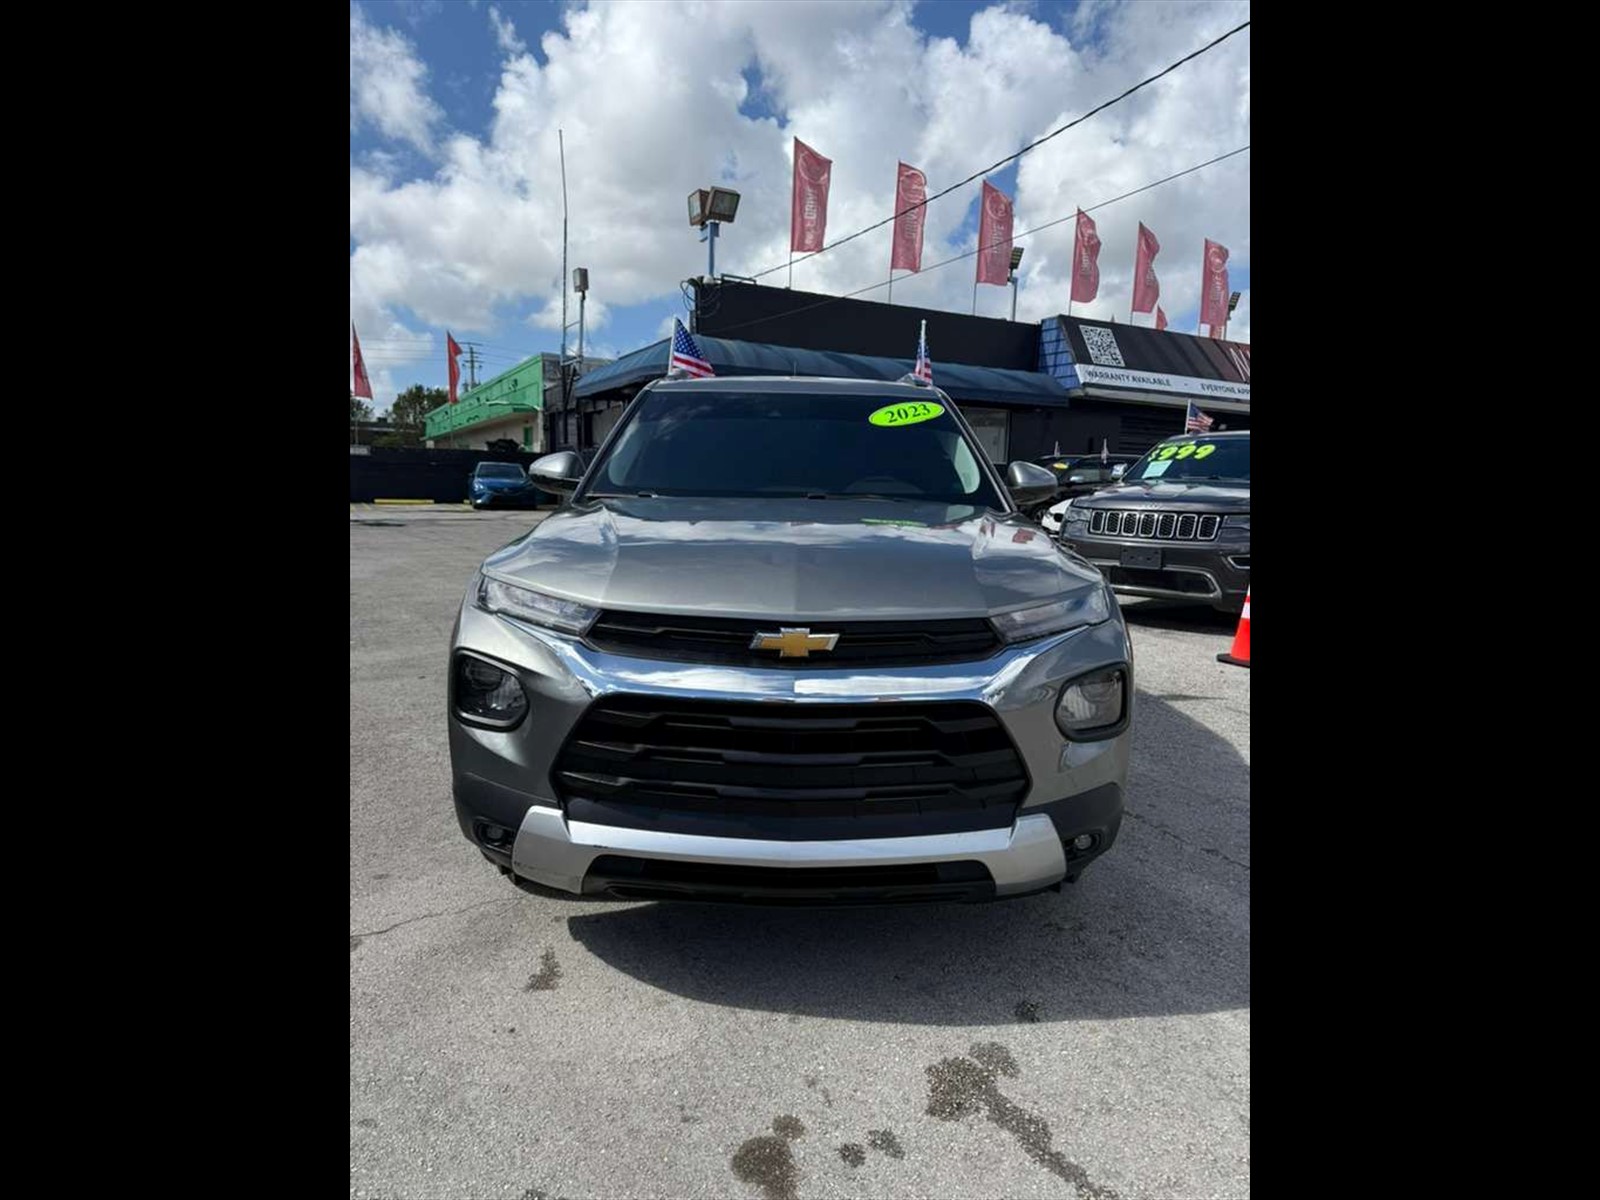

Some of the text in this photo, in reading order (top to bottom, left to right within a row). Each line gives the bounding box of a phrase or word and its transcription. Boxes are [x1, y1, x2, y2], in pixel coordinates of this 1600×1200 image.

[1086, 370, 1250, 395] WARRANTY AVAILABLE EVERYONE APP
[884, 403, 931, 423] 2023
